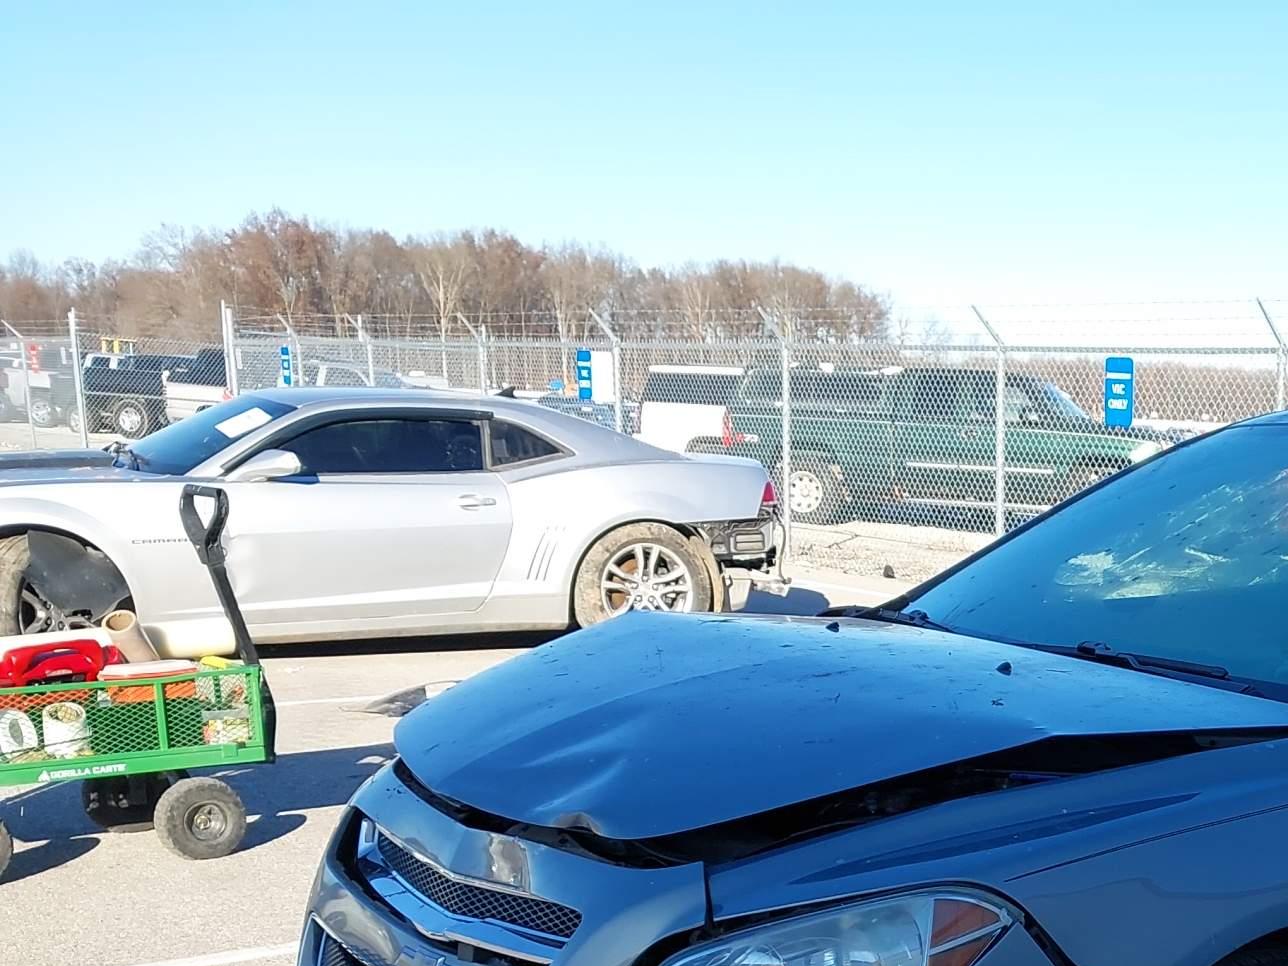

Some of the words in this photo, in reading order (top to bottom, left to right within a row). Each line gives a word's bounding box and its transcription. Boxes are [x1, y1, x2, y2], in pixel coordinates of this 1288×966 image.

[1111, 383, 1126, 395] VIC
[1107, 398, 1128, 410] ONLY
[49, 766, 91, 780] GORILLA
